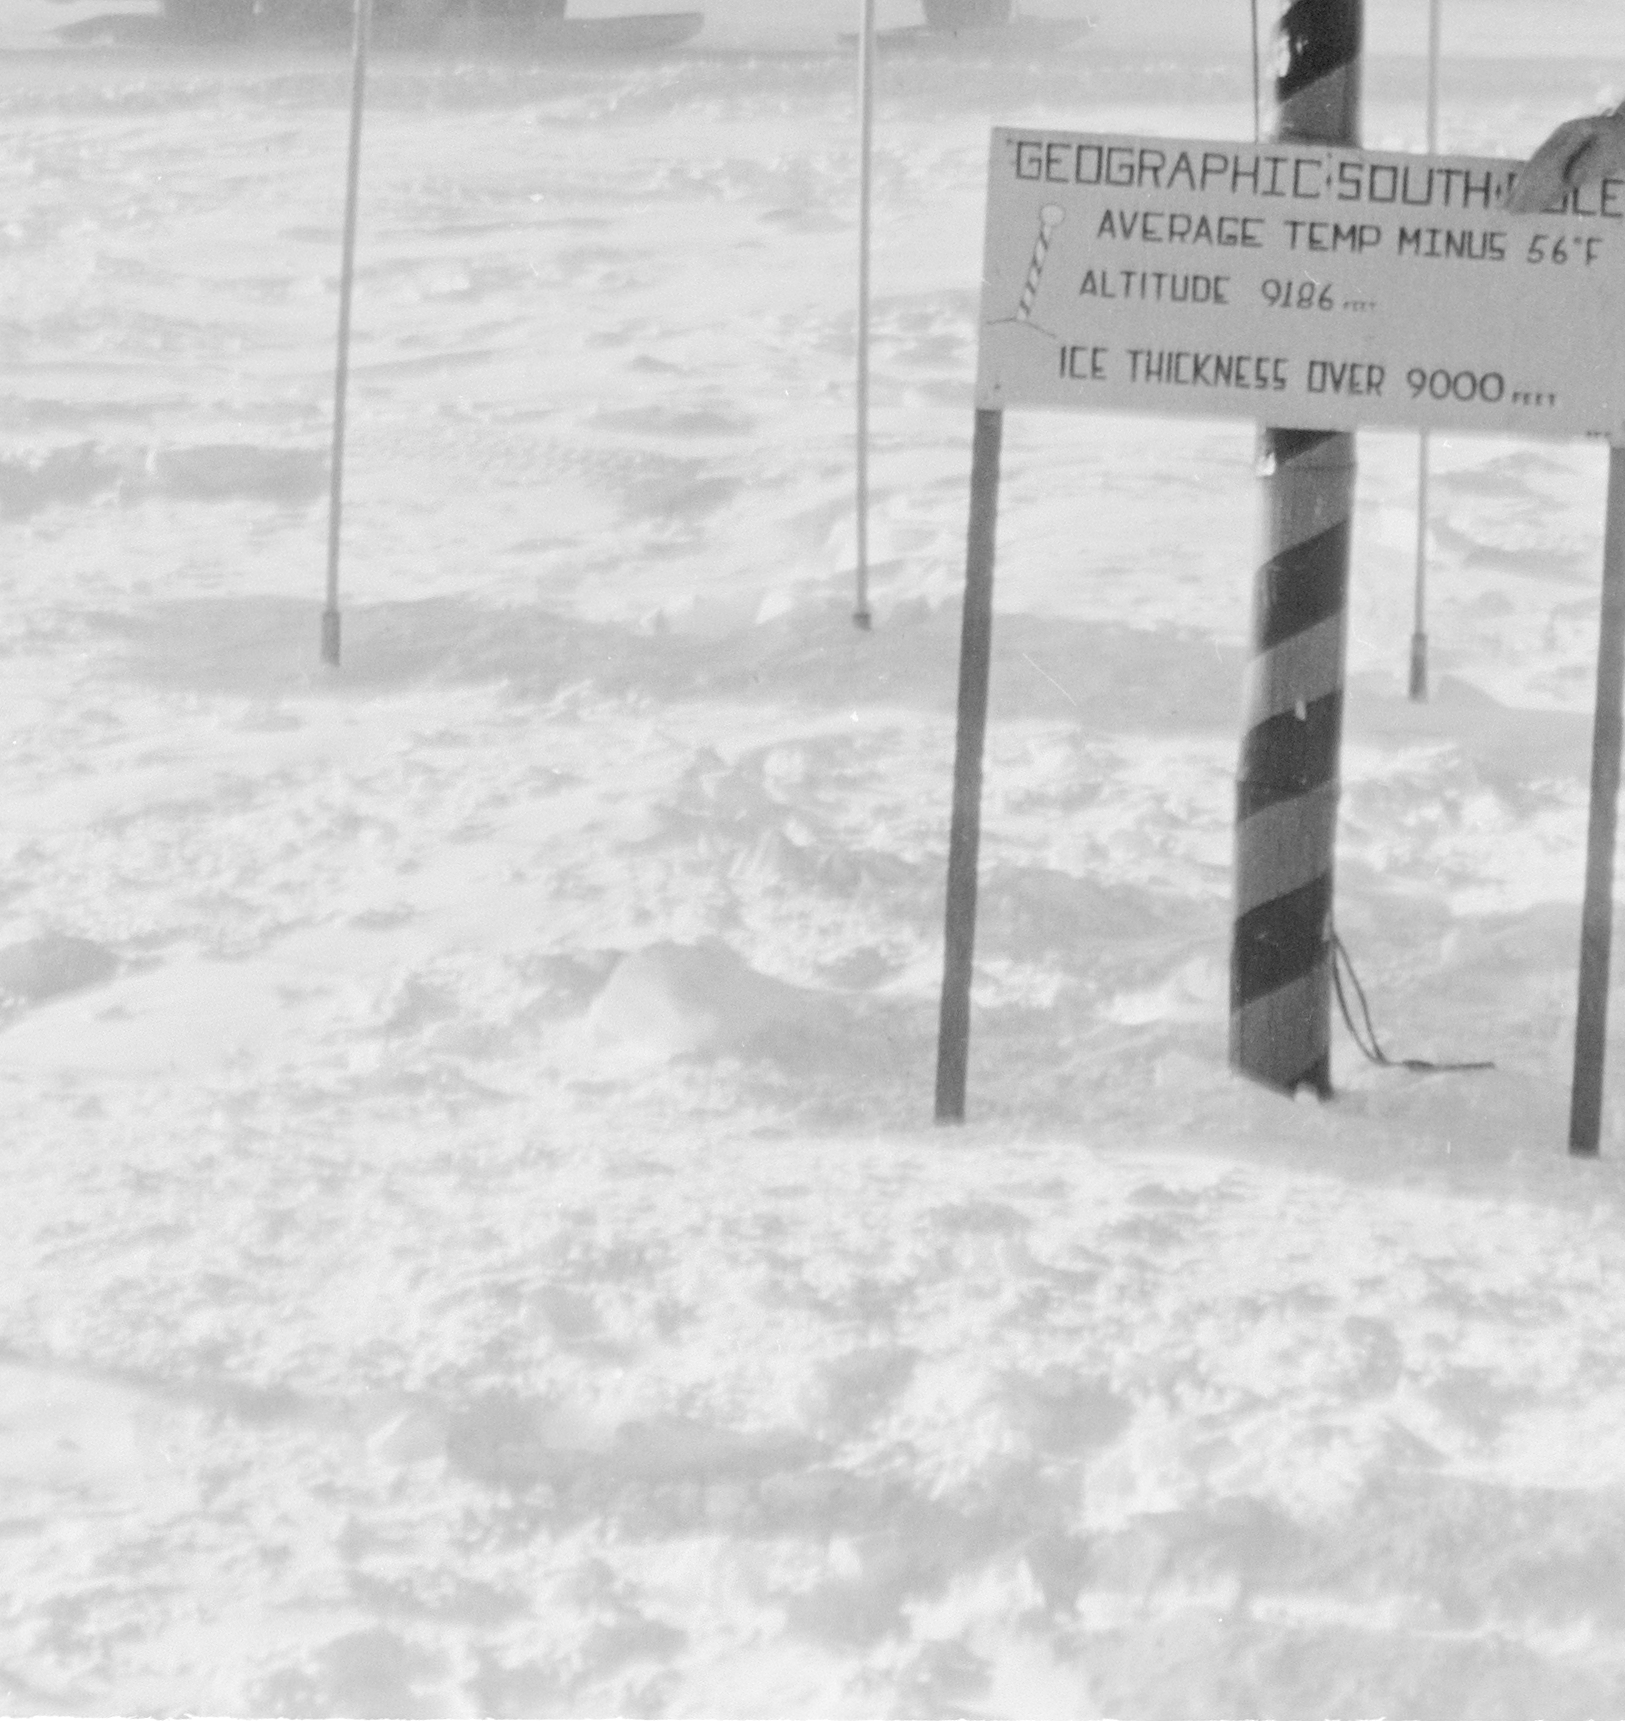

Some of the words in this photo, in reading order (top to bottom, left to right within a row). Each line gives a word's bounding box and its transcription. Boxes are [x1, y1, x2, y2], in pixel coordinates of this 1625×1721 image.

[1014, 141, 1323, 198] GEOGRAPHIC
[1338, 160, 1492, 210] SOUTH
[1505, 172, 1625, 219] LE
[1096, 209, 1265, 247] AVERAGE
[1284, 220, 1381, 254] TEMP
[1397, 228, 1506, 262] MINUS
[1078, 269, 1231, 305] ALTITUDE
[1260, 279, 1335, 311] 9186
[1058, 345, 1109, 380] ICE
[1126, 349, 1288, 391] THICKNESS
[1307, 360, 1385, 397] OVER
[1406, 368, 1505, 403] 9000
